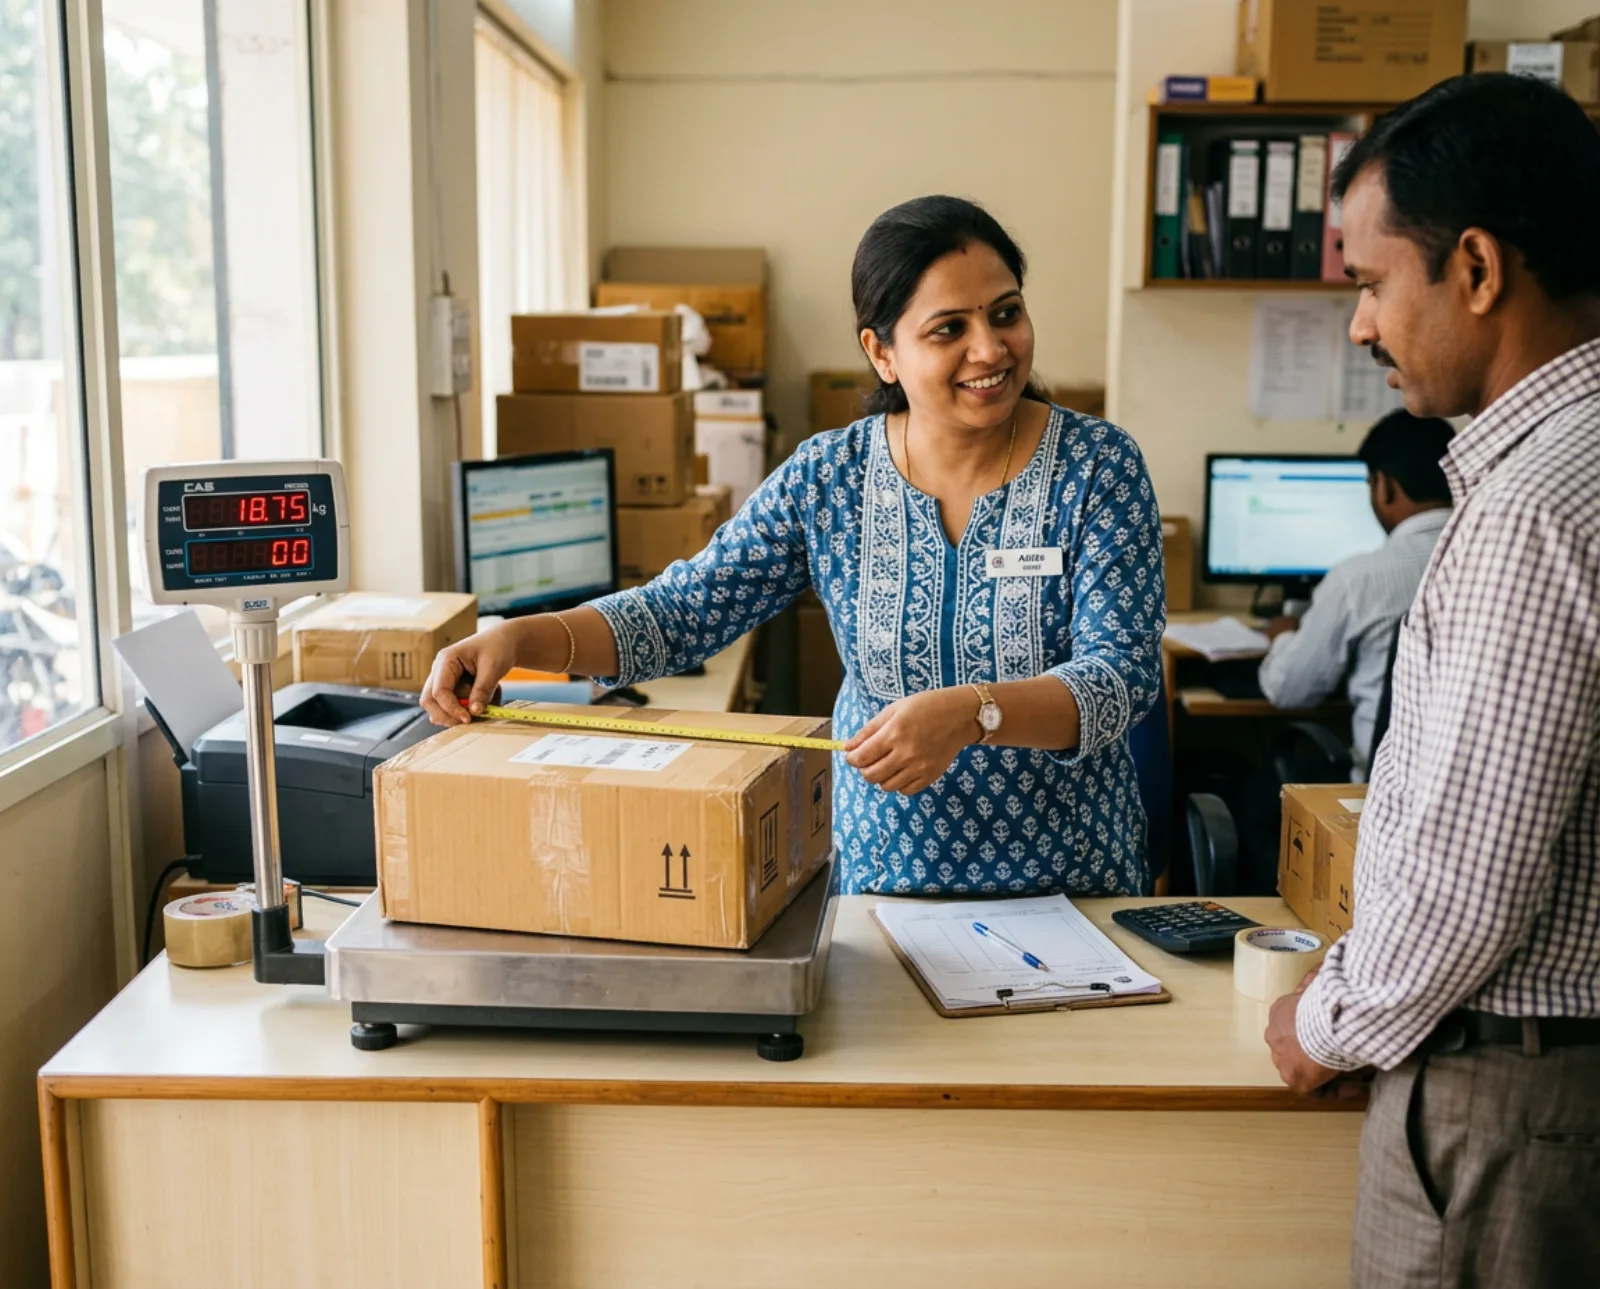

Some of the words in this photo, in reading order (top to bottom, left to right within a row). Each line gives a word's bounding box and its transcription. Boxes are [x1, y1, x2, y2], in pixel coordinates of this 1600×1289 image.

[238, 495, 306, 521] 18.75
[312, 503, 327, 516] kg
[271, 540, 309, 566] 00
